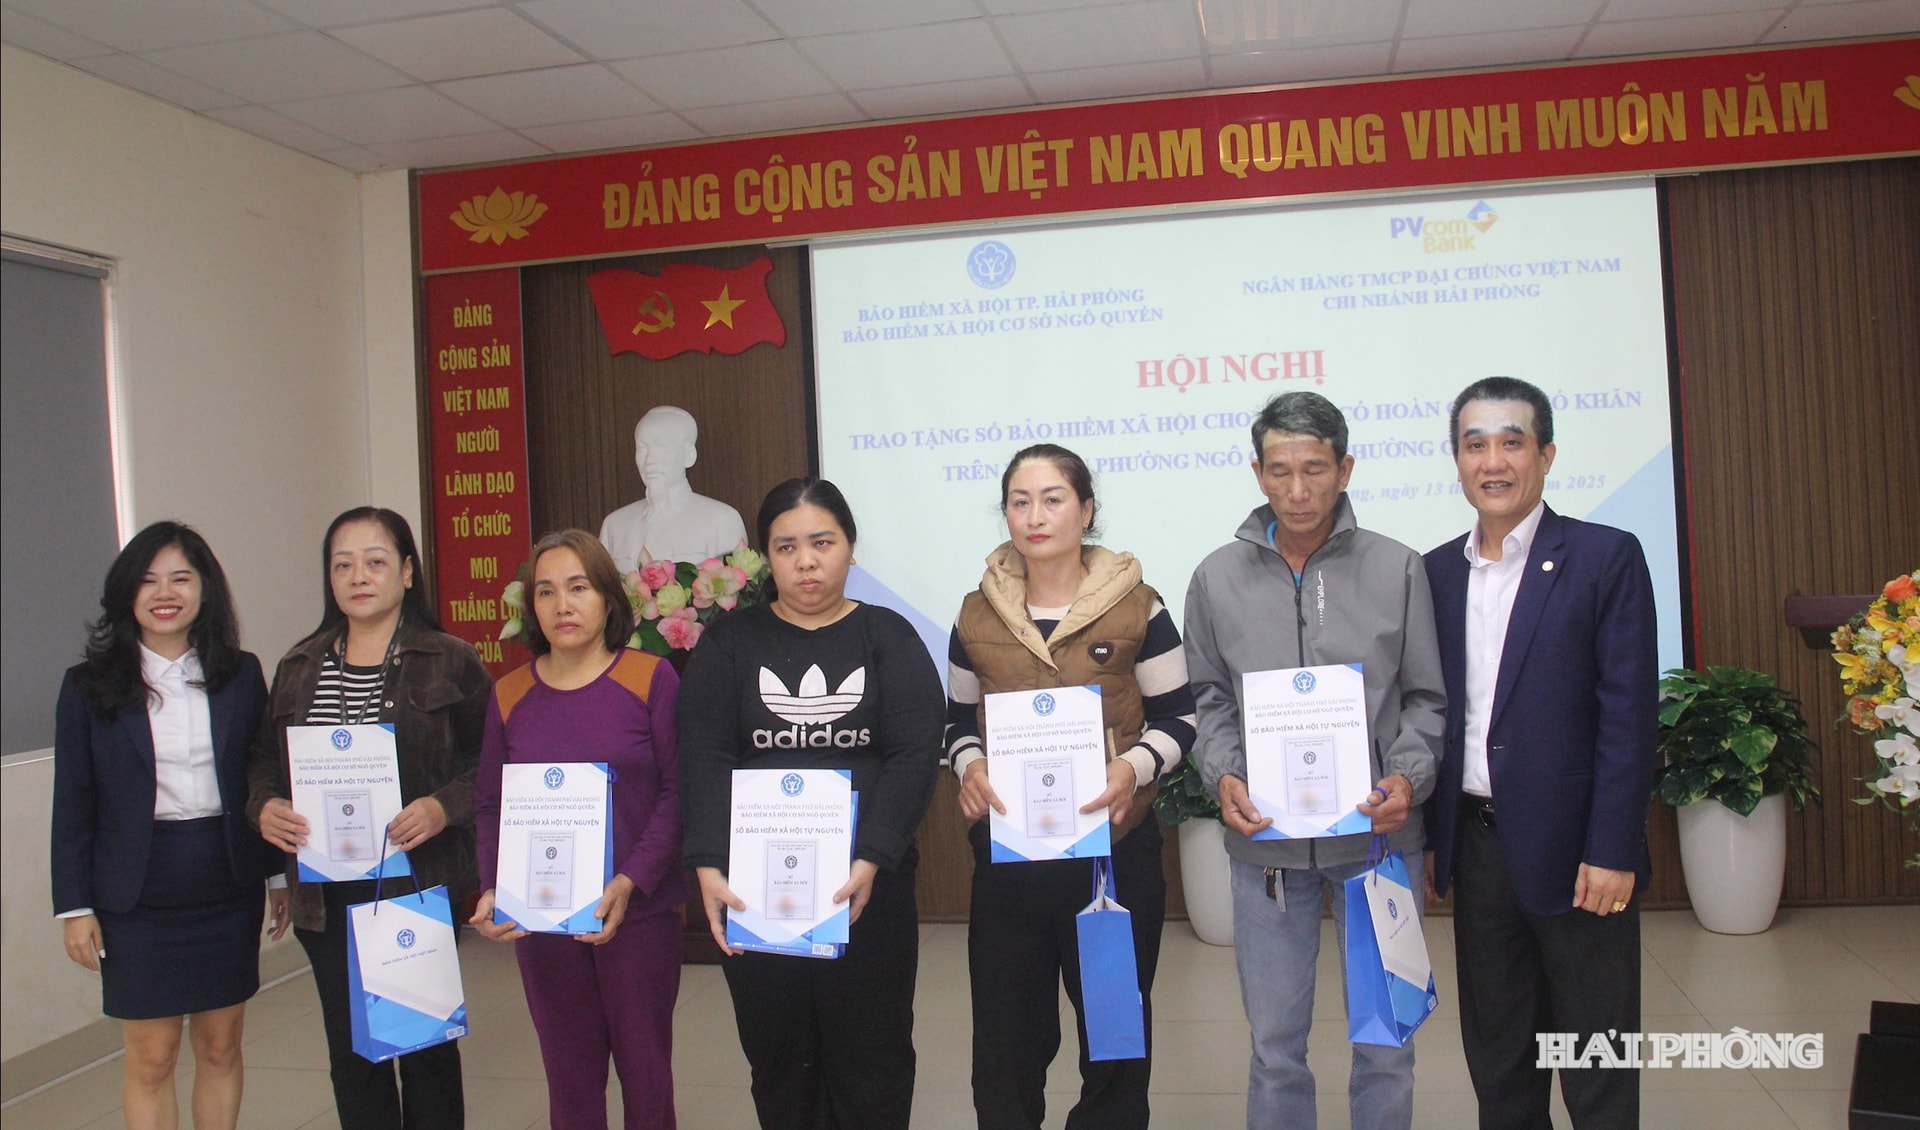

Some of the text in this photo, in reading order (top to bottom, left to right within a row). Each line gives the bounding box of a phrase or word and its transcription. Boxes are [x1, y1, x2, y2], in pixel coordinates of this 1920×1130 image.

[603, 72, 1828, 229] ĐẢNG CỘNG SẢN VIỆT NAM QUANG VINH MUÔN NĂM
[1390, 216, 1468, 240] PVcom
[1422, 234, 1476, 254] Bank
[1242, 258, 1621, 294] NGÂN HÀNG TMCP ĐẠI CHÚNG VIỆT NAM
[858, 289, 1144, 322] BẢO HIỂM XÃ HỘI TP. HẢI PHÒNG
[1322, 284, 1540, 310] CHI NHÁNH HẢI PHÒNG
[454, 299, 492, 328] ĐẢNG
[842, 306, 1163, 343] BẢO HIỂM XÃ HỘI CƠ SỞ NGÔ QUYỀN
[439, 338, 511, 375] CỘNG SẢN
[1136, 350, 1327, 394] HỘI NGHỊ
[443, 386, 510, 416] VIỆT NAM
[1575, 388, 1642, 409] KHĂN
[456, 425, 500, 453] NGƯỜI
[848, 412, 1251, 450] TRAO TẶNG SỔ BẢO HIỂM XÃ HỘI CHO
[1095, 448, 1190, 474] PHƯỜNG
[1194, 445, 1244, 468] NGÔ
[1350, 437, 1435, 461] HƯỜNG
[445, 470, 515, 498] LÃNH ĐẠO
[942, 460, 998, 481] TRÊN
[1566, 474, 1606, 490] 2025
[1424, 482, 1444, 496] 13
[452, 507, 512, 538] TỔ CHỨC
[470, 557, 498, 583] MỌI
[450, 592, 496, 622] THẮNG
[752, 724, 871, 749] adidas
